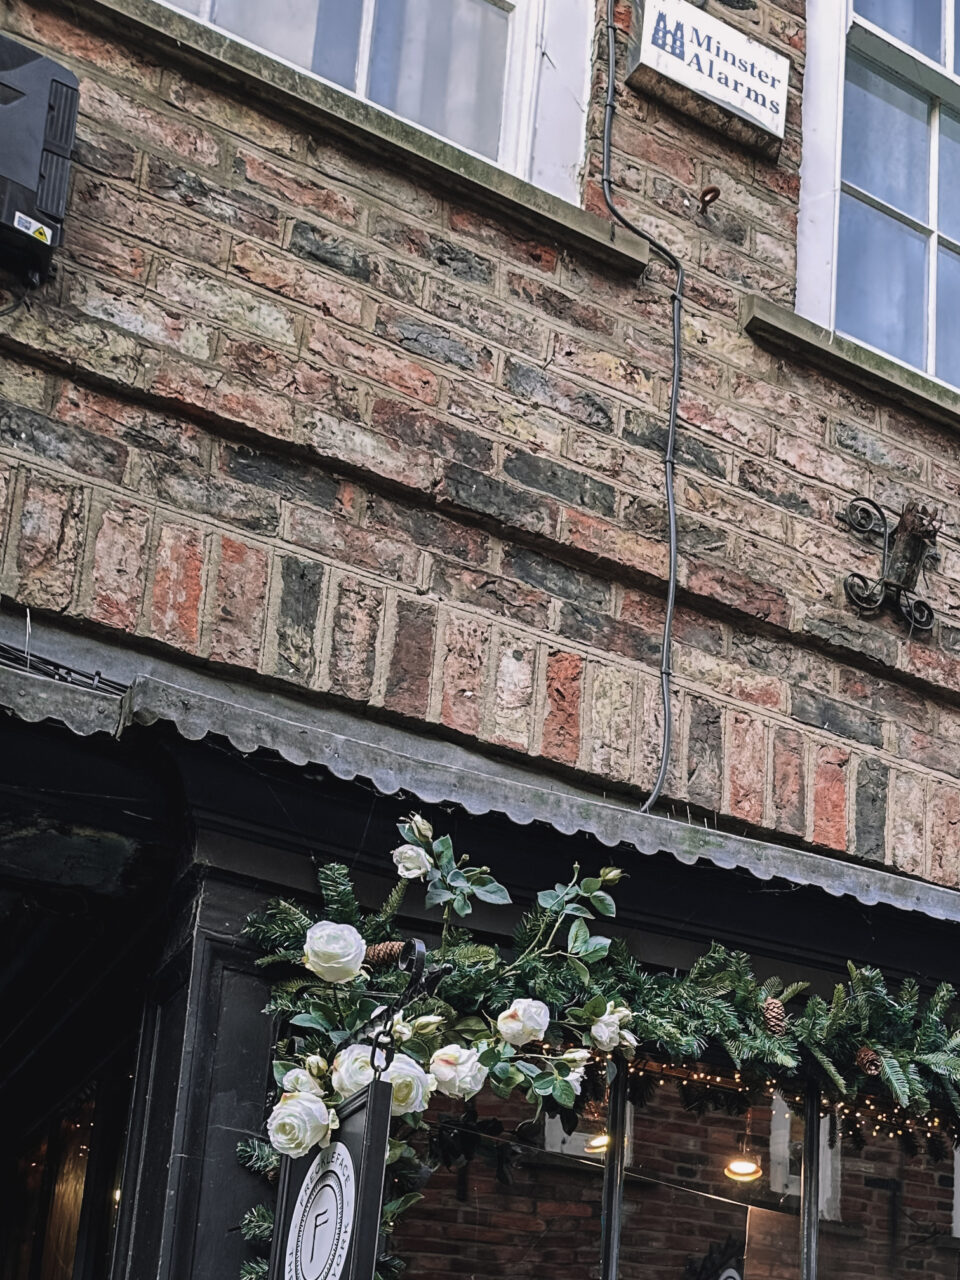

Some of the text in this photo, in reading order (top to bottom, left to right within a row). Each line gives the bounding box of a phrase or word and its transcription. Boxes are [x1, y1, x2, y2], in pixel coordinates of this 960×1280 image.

[686, 52, 780, 115] Alarms
[689, 26, 781, 90] Minster
[299, 1151, 351, 1207] FRECKLEFACE
